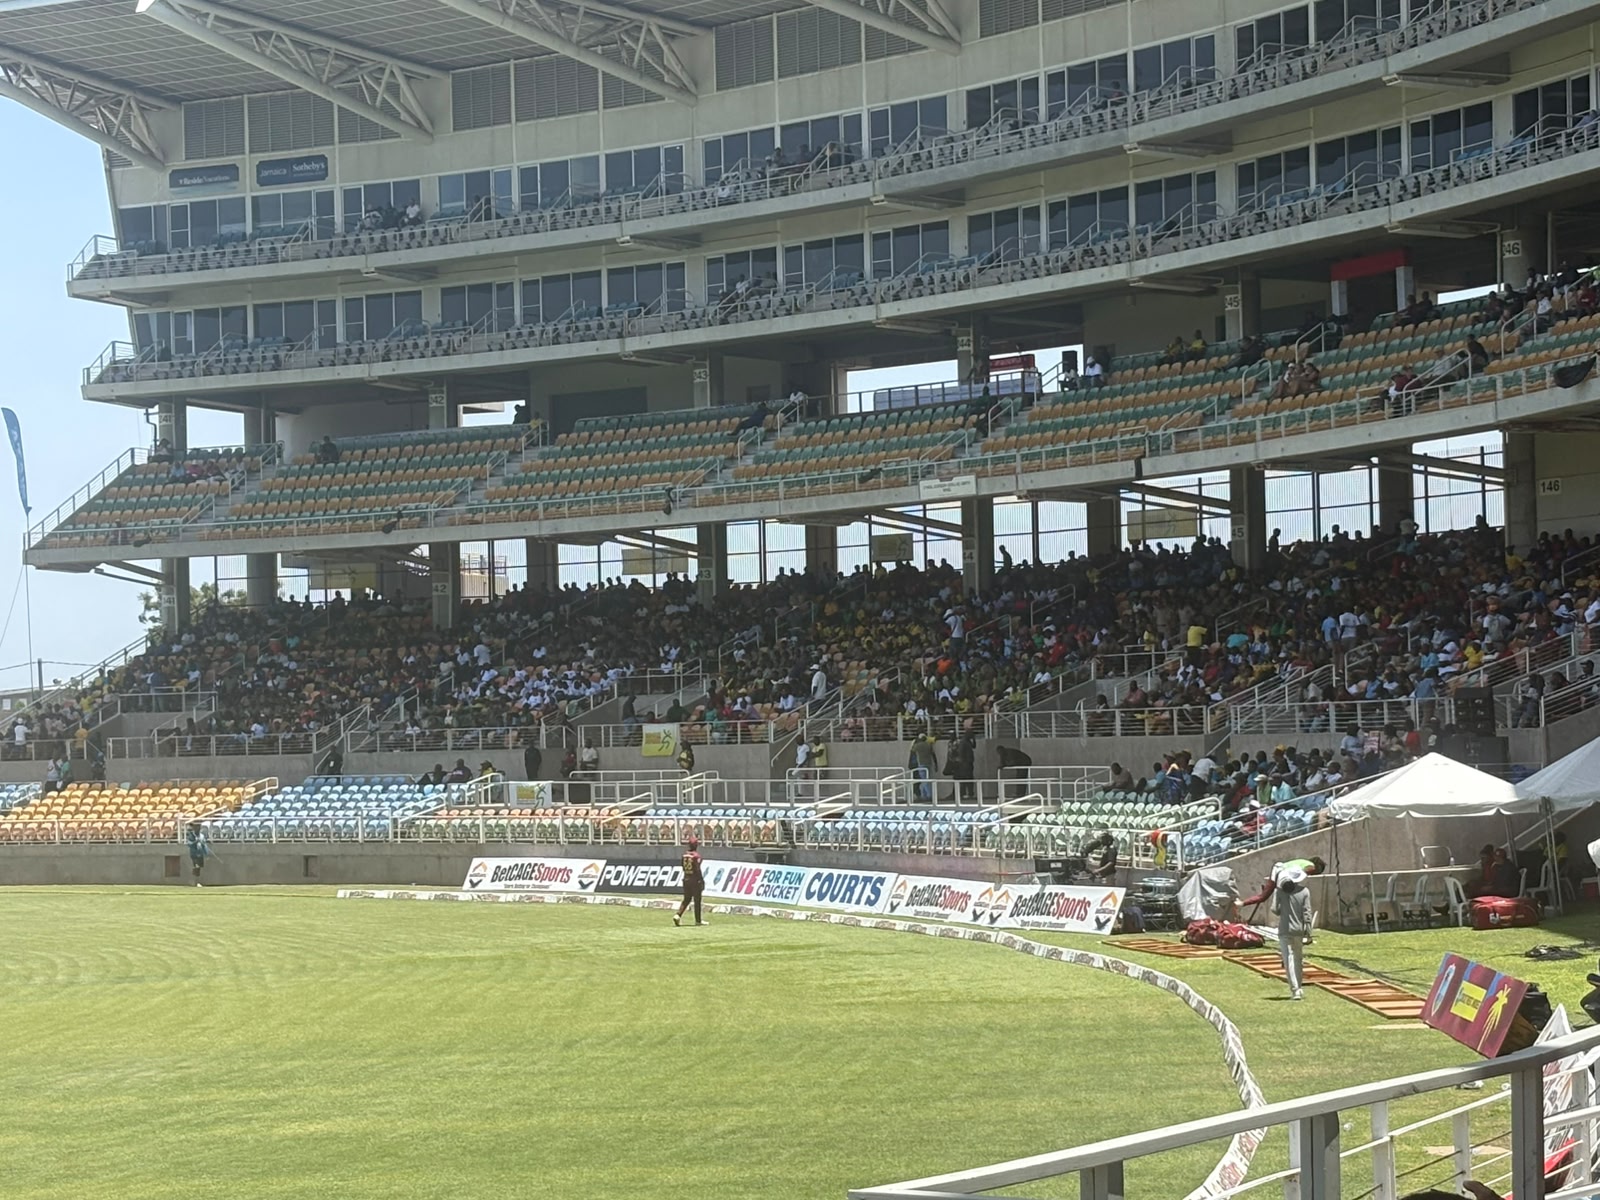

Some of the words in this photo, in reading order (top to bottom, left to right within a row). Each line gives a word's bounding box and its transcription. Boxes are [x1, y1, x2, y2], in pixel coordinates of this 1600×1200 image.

[1541, 480, 1560, 493] 146
[490, 862, 573, 884] BetCAGESports
[721, 866, 763, 895] FIVE
[760, 869, 783, 883] FOR
[783, 871, 805, 885] FUN
[755, 884, 800, 901] CRICKET
[805, 872, 886, 907] COURTS
[904, 883, 971, 913] BetCAGESports
[1008, 891, 1091, 922] BetCAGESports
